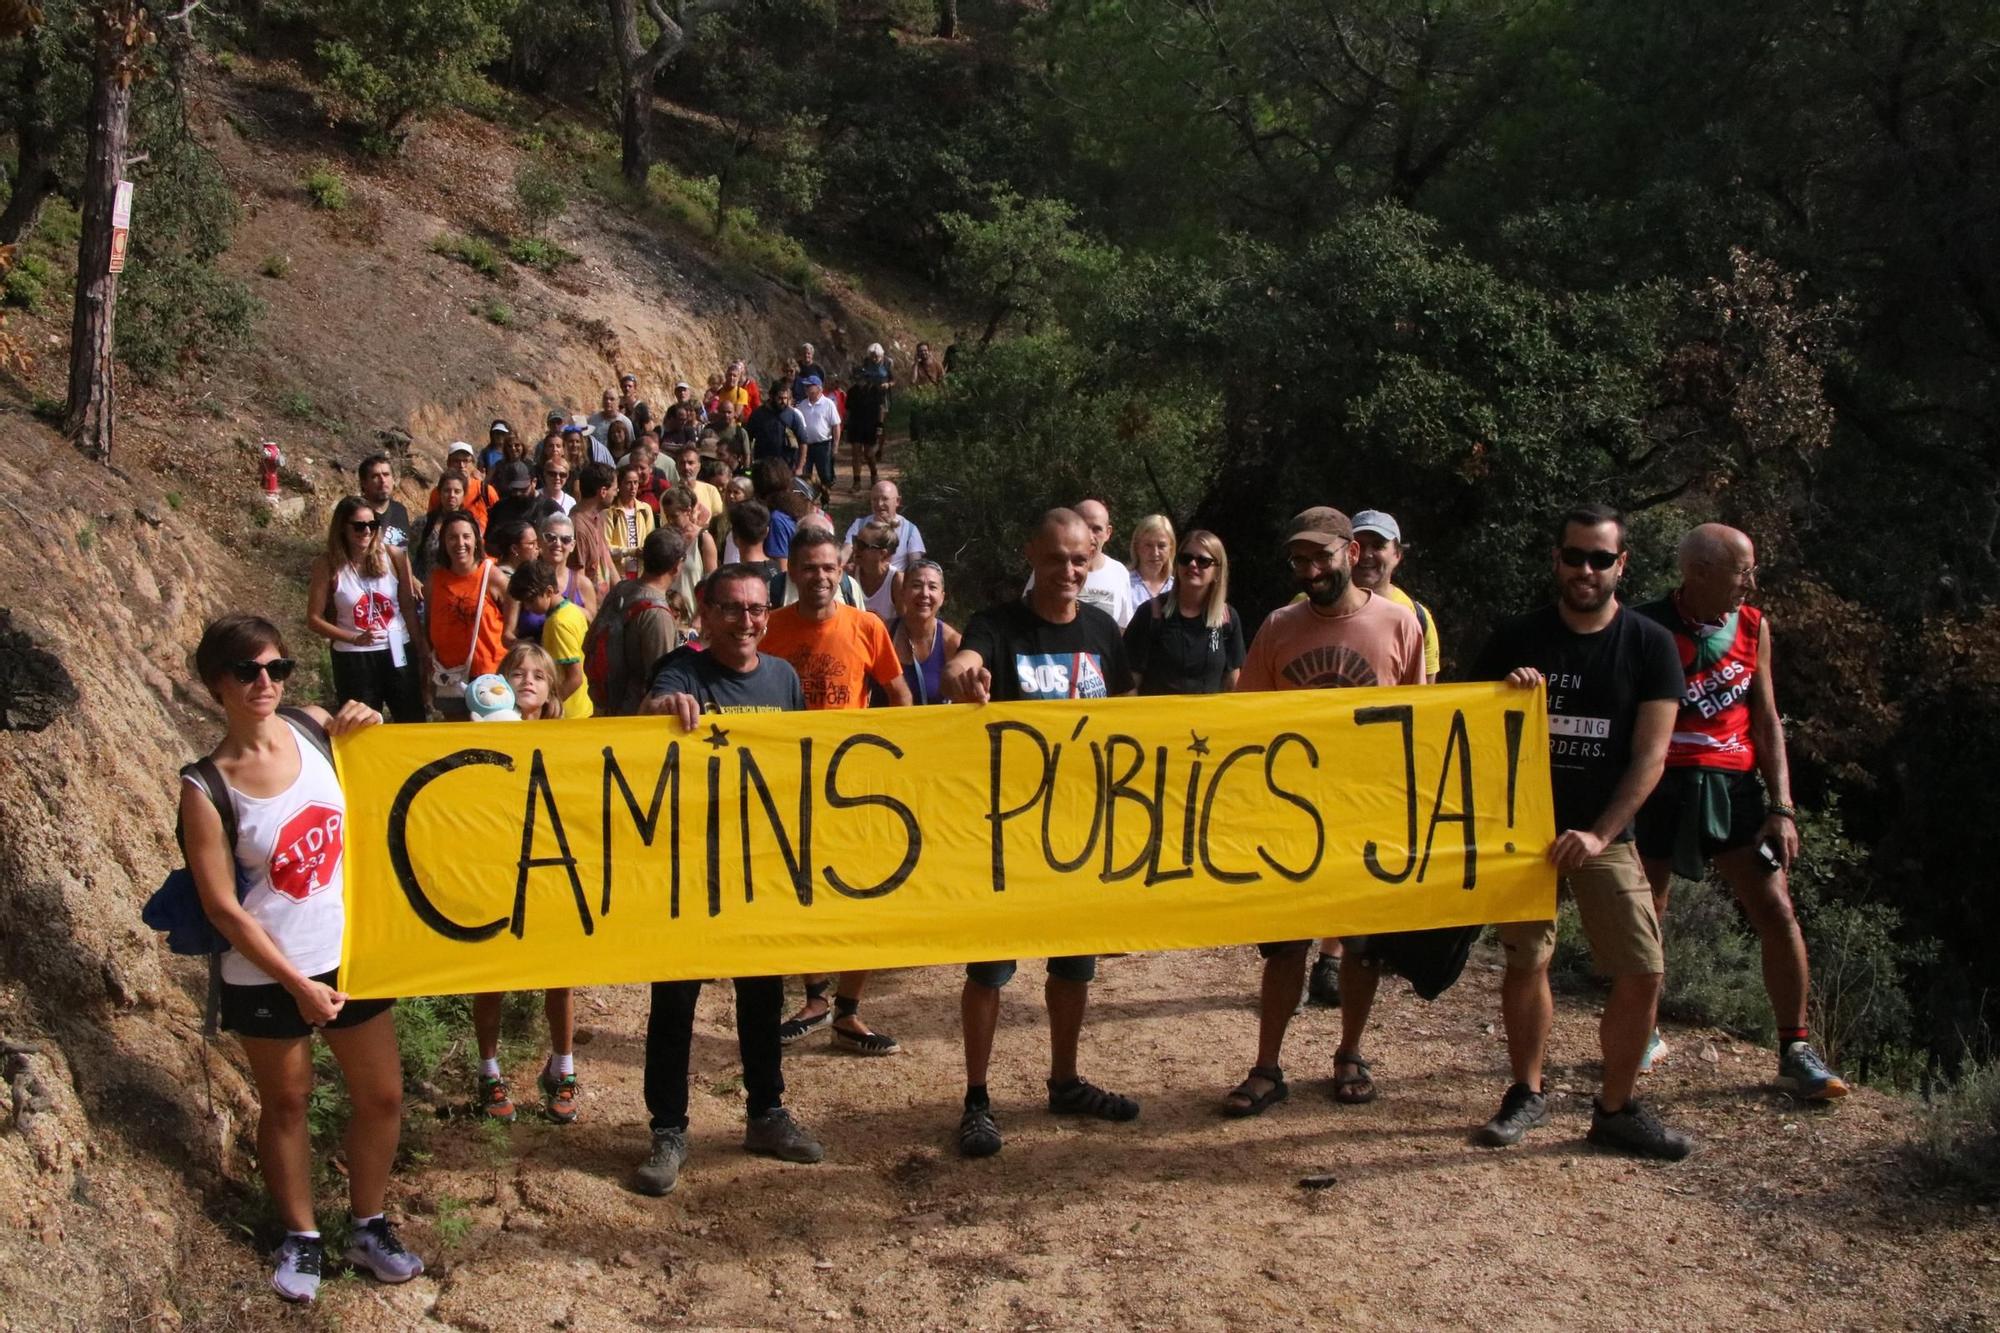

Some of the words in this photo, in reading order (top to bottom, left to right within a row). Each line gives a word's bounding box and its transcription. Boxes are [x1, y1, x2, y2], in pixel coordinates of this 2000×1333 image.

[1017, 664, 1069, 693] SOS
[1541, 672, 1582, 690] PEN
[1354, 705, 1525, 890] JA!
[275, 814, 341, 872] STOP
